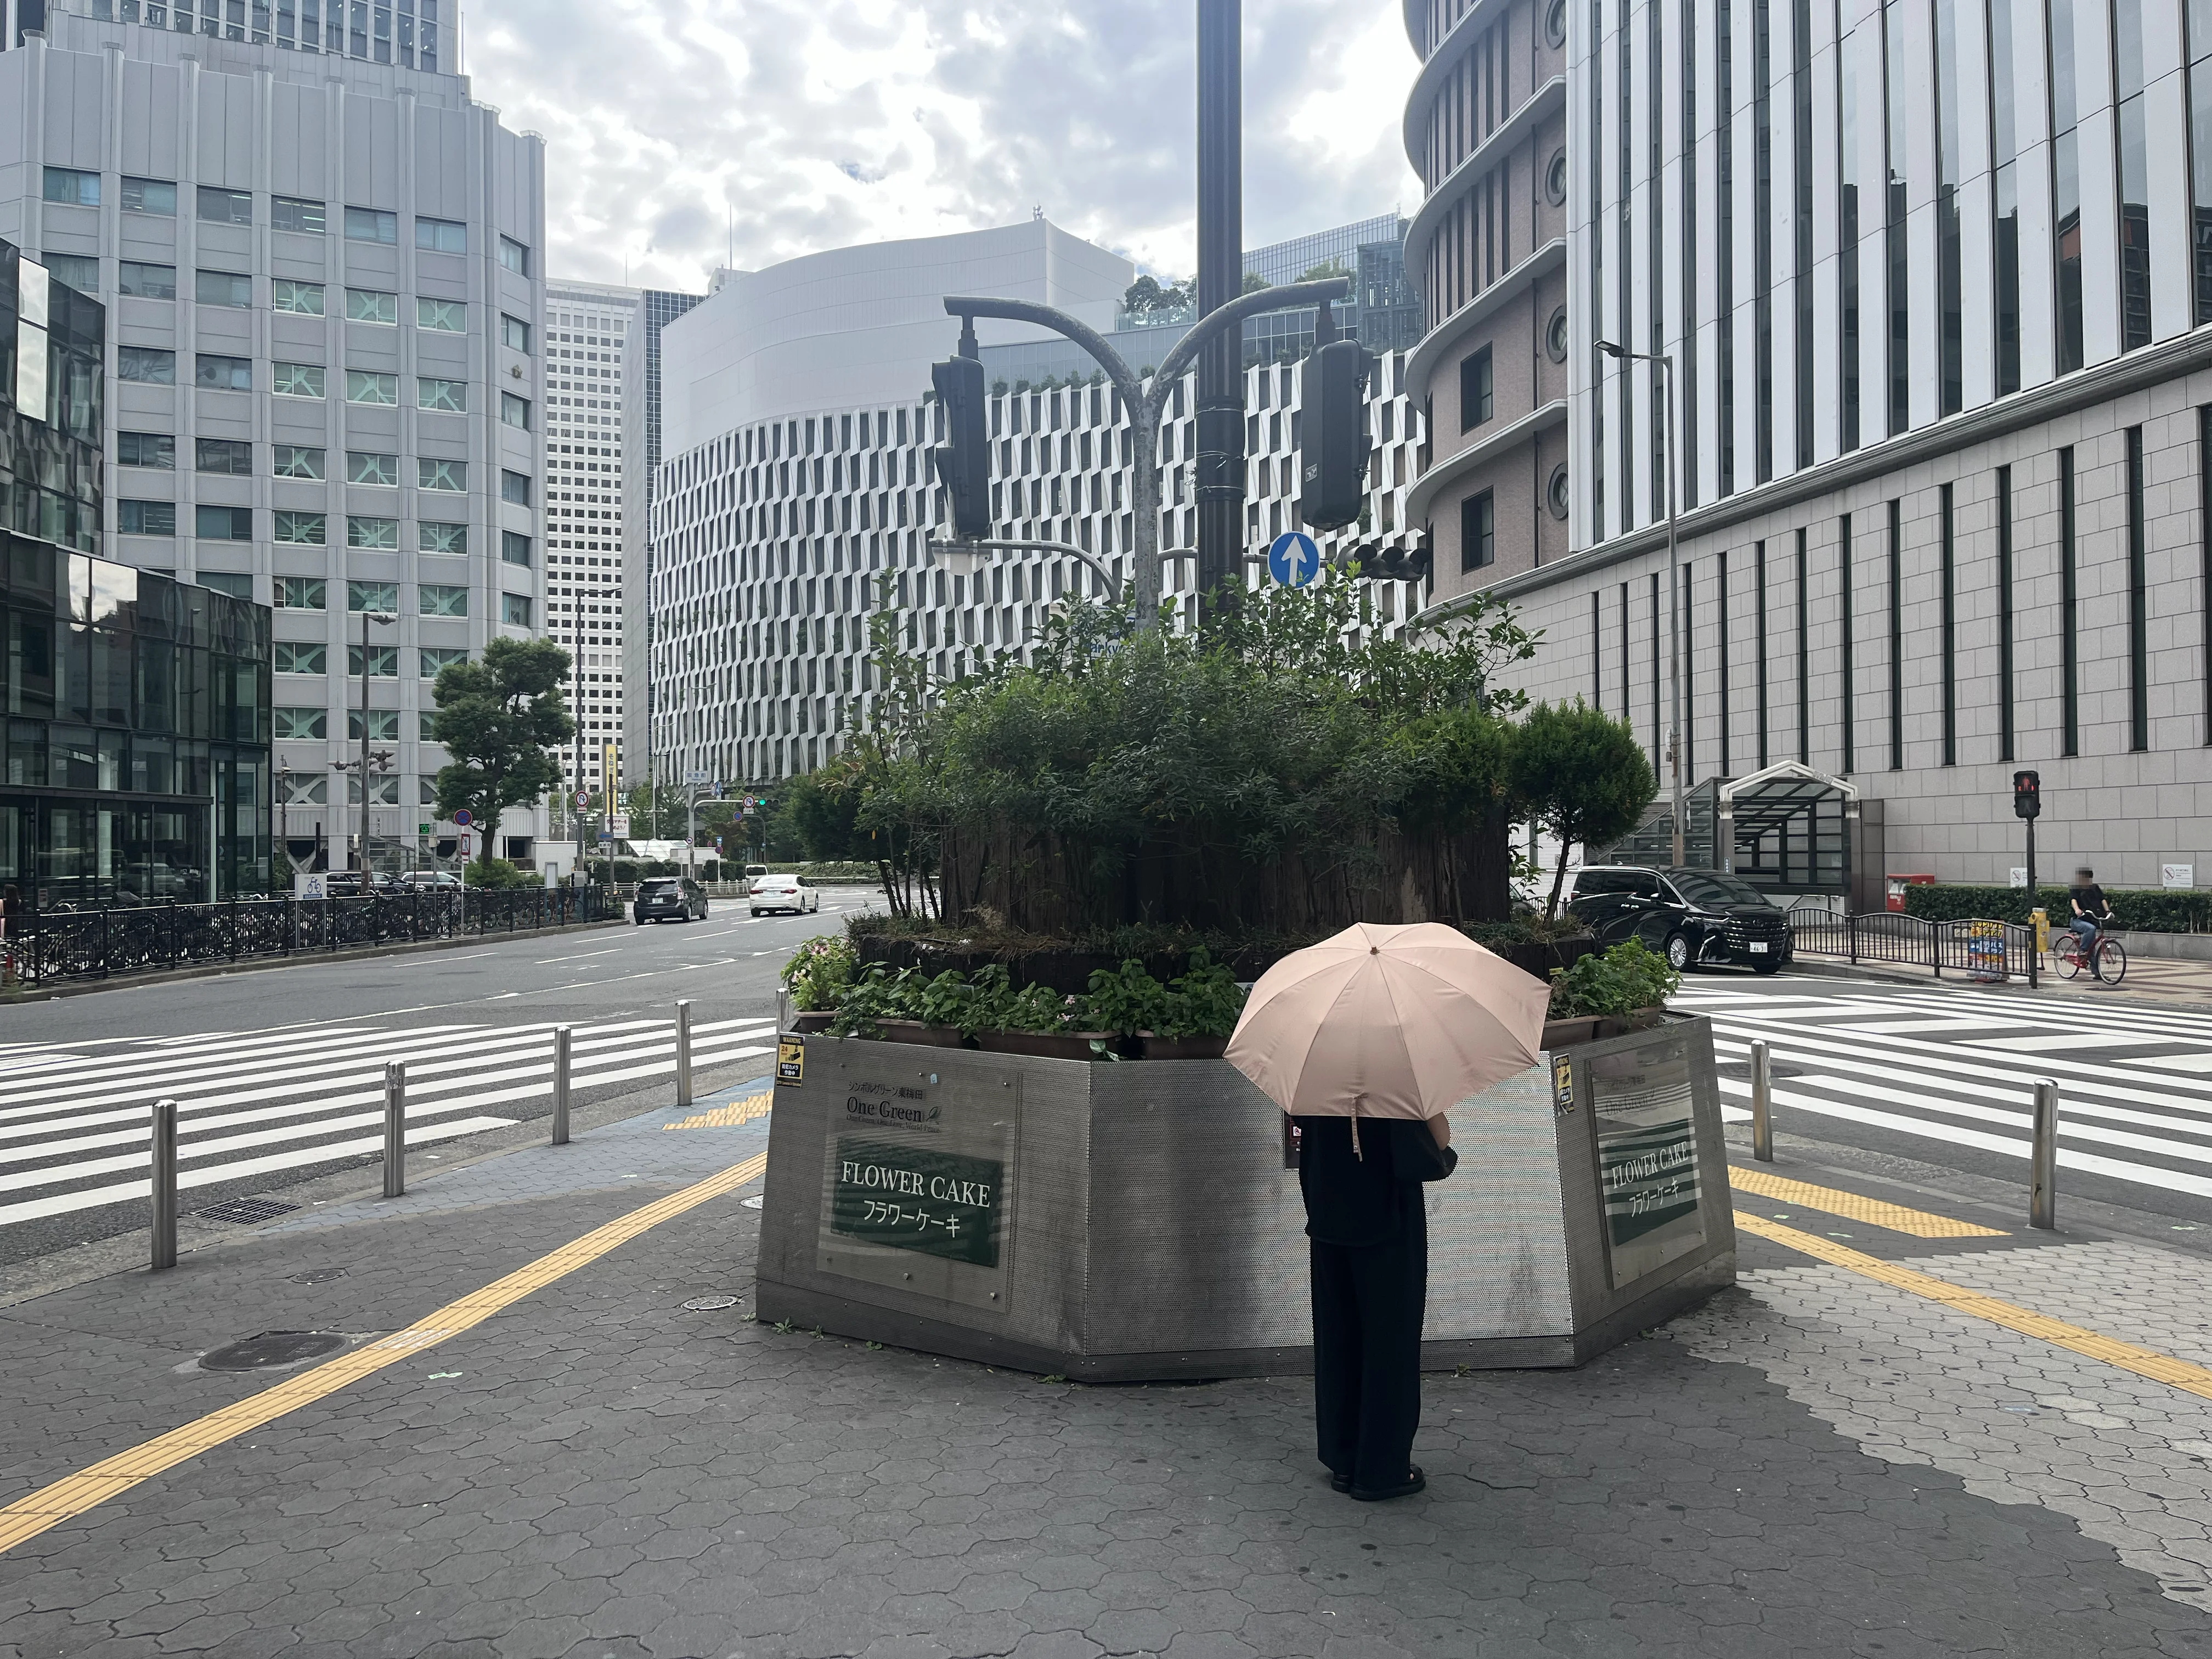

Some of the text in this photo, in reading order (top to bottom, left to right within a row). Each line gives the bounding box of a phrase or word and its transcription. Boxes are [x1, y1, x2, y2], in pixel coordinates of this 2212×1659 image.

[847, 1096, 922, 1122] One Green
[1606, 1099, 1622, 1116] One
[841, 1160, 990, 1207] FLOWER CAKE
[1611, 1141, 1689, 1189] FLOWER CAKE
[1629, 1176, 1679, 1217] フラワーケーキ
[864, 1200, 960, 1238] フラワーケーキ
